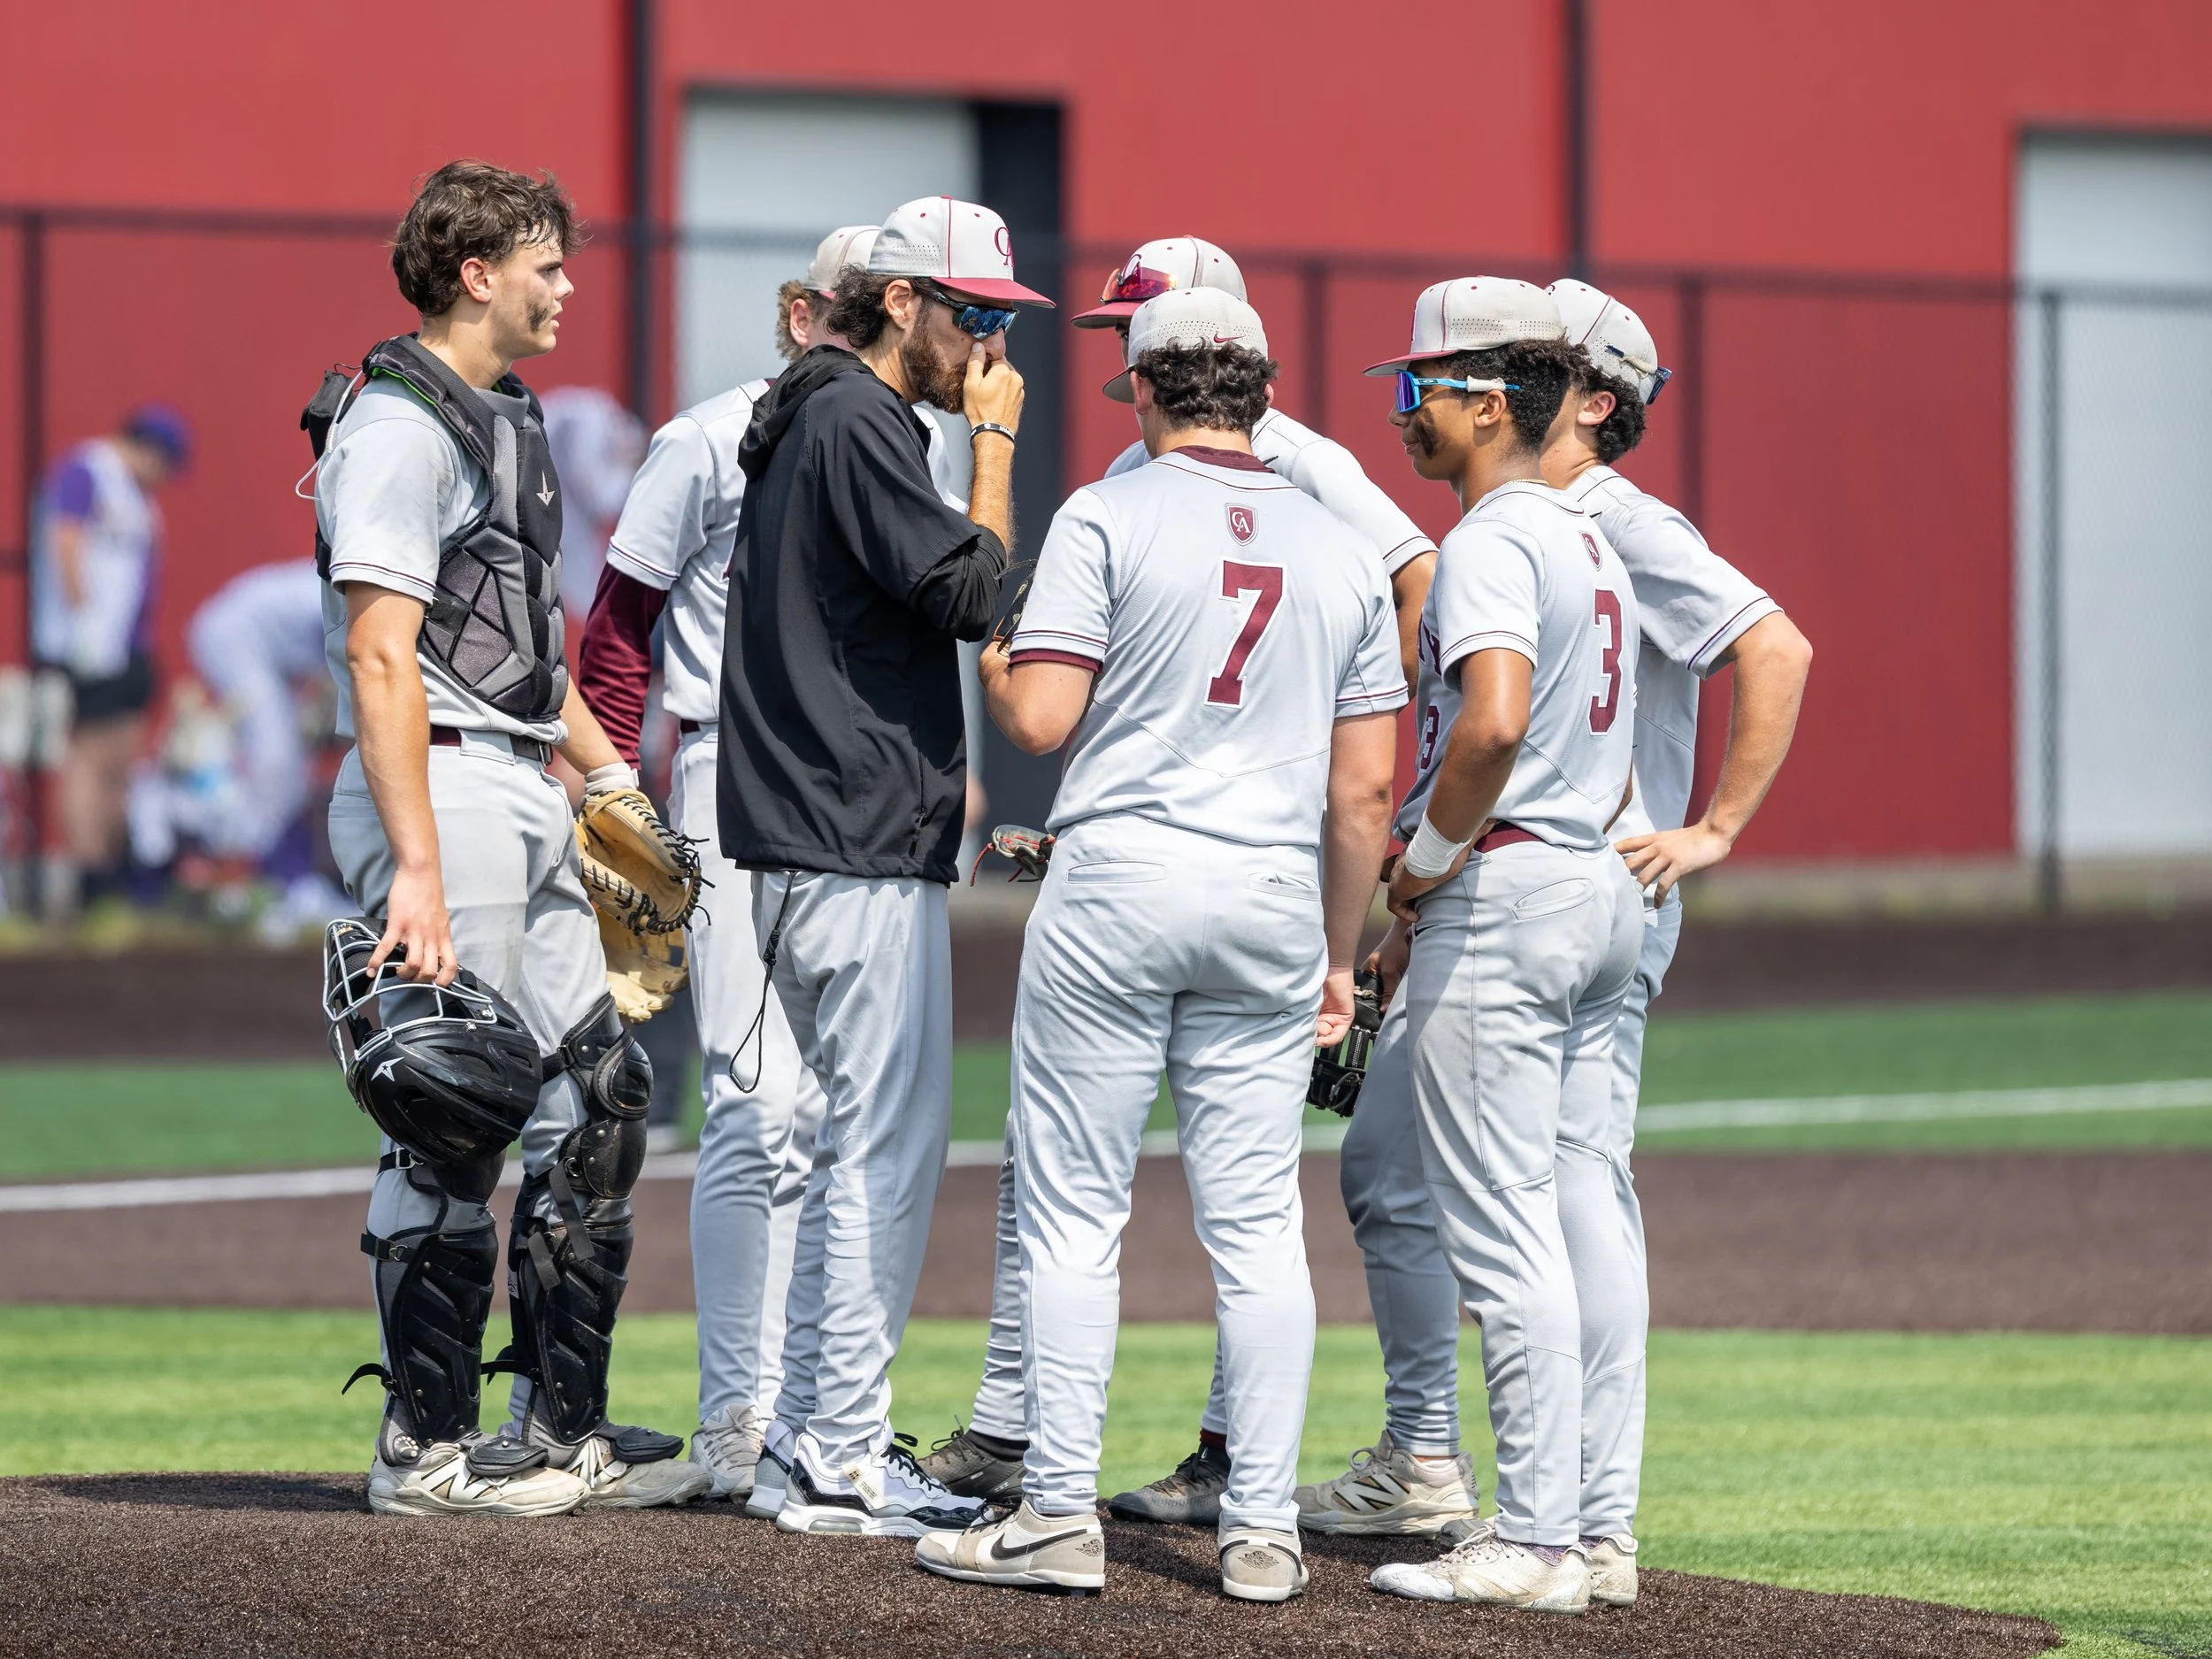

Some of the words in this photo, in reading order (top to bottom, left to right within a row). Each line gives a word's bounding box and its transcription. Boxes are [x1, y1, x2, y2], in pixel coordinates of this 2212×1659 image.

[1232, 511, 1252, 534] CA
[1206, 558, 1285, 706] 7
[1588, 588, 1624, 733] 3
[1420, 704, 1440, 771] 3
